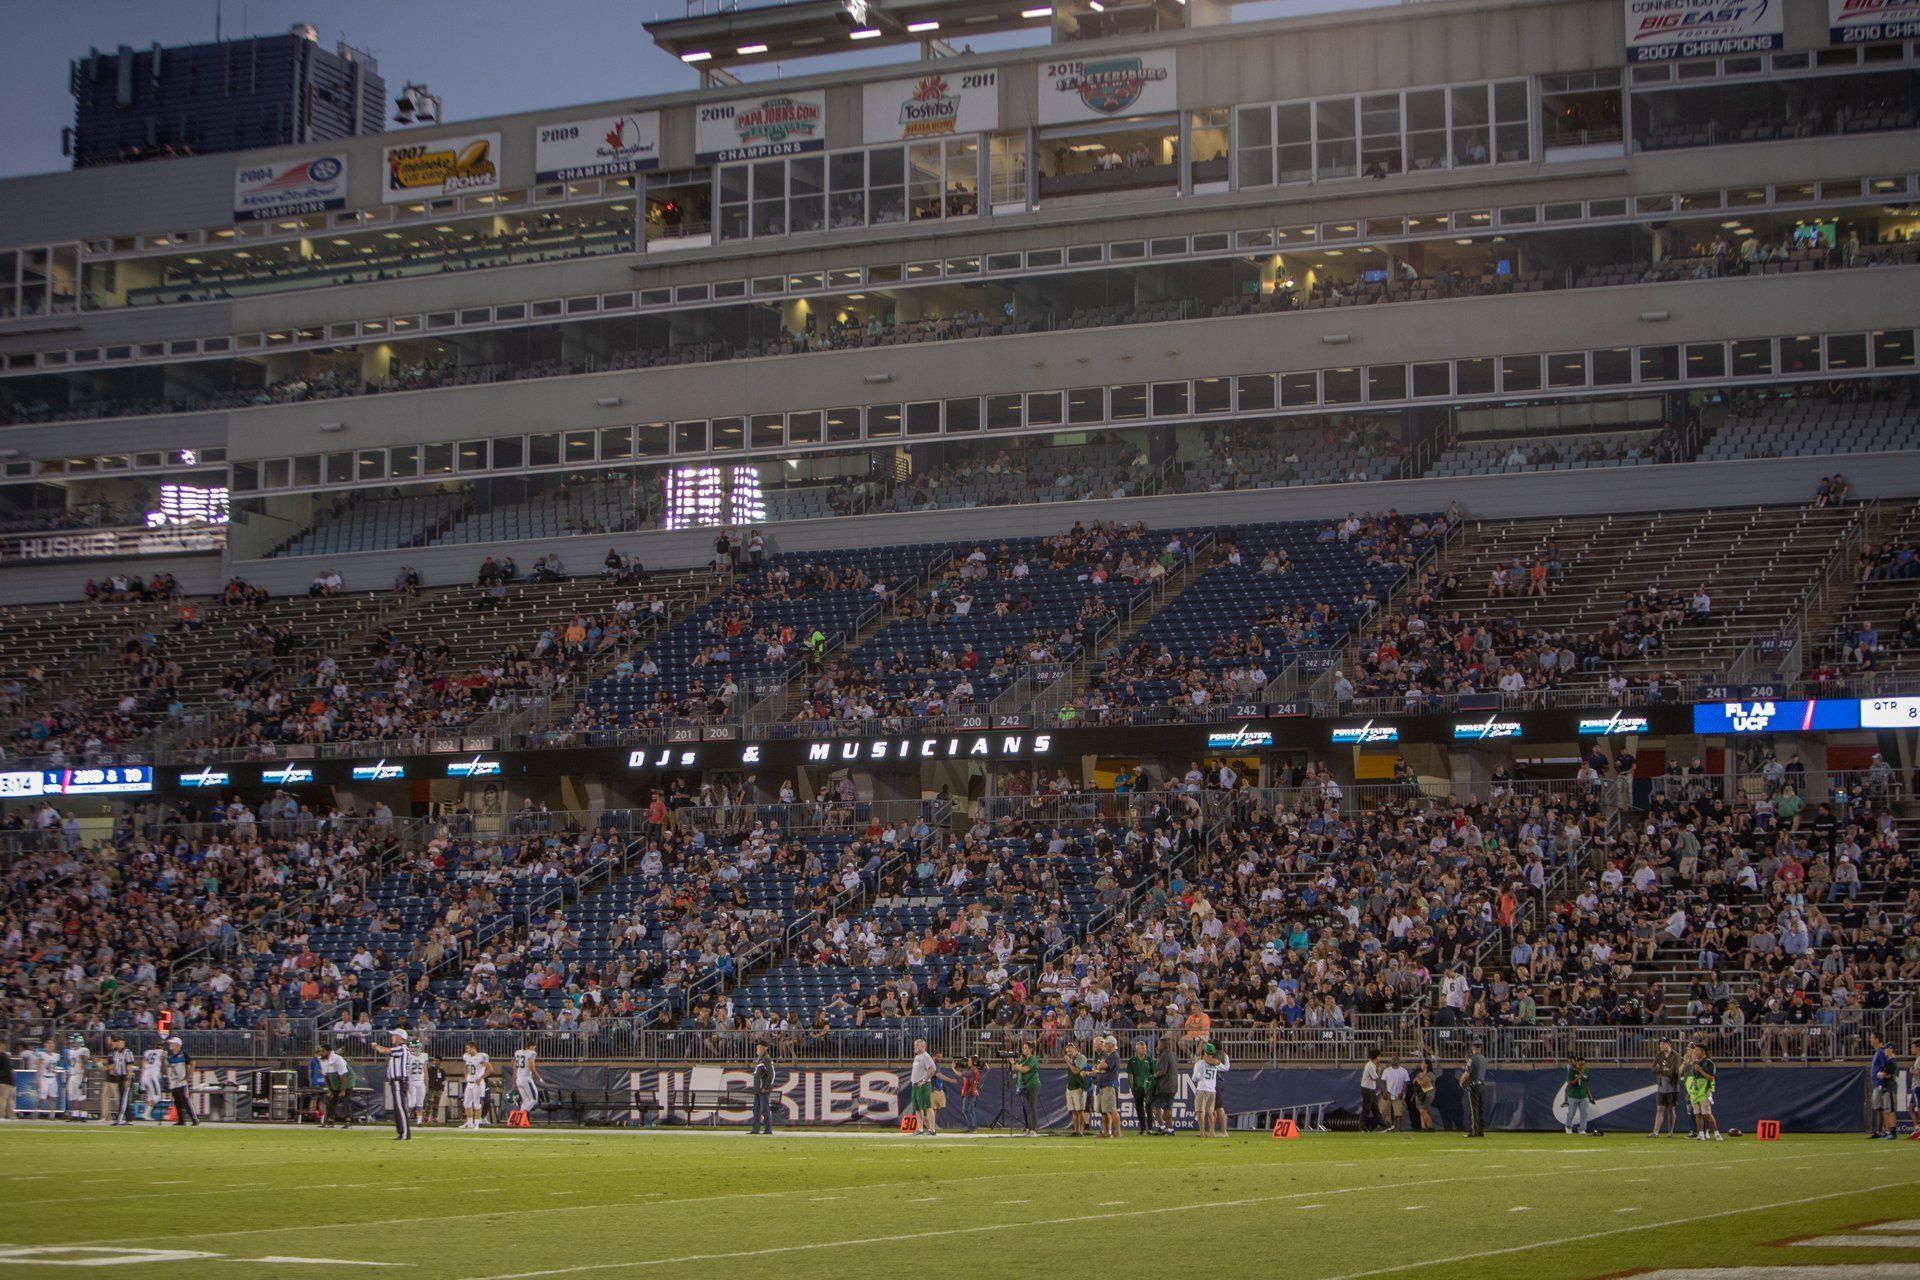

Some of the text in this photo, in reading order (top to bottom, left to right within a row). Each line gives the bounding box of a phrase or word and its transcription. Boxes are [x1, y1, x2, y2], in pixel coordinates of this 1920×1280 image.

[1639, 8, 1747, 30] BIG EAST
[1842, 25, 1880, 42] 2010
[1637, 36, 1773, 60] 2007 CHAMPIONS
[961, 73, 995, 89] 2011
[701, 106, 735, 122] 2010
[541, 126, 580, 143] 2009
[718, 142, 802, 161] CHAMPIONS
[556, 161, 637, 180] CHAMPIONS
[252, 200, 326, 219] CHAMPIONS
[1706, 685, 1774, 698] 241 240
[1237, 703, 1297, 715] 242 241
[1725, 703, 1747, 717] FL
[1872, 700, 1897, 711] QTR
[962, 715, 1019, 727] 200 242
[1732, 716, 1768, 731] UCF
[675, 729, 729, 740] 201 200
[437, 738, 486, 751] 202 201
[743, 746, 759, 762] &
[808, 735, 1052, 761] MUSICIANS
[157, 1010, 172, 1033] 2
[1204, 1069, 1217, 1081] 51
[901, 1116, 918, 1131] 30
[1273, 1120, 1290, 1136] 20
[1762, 1123, 1778, 1137] 10
